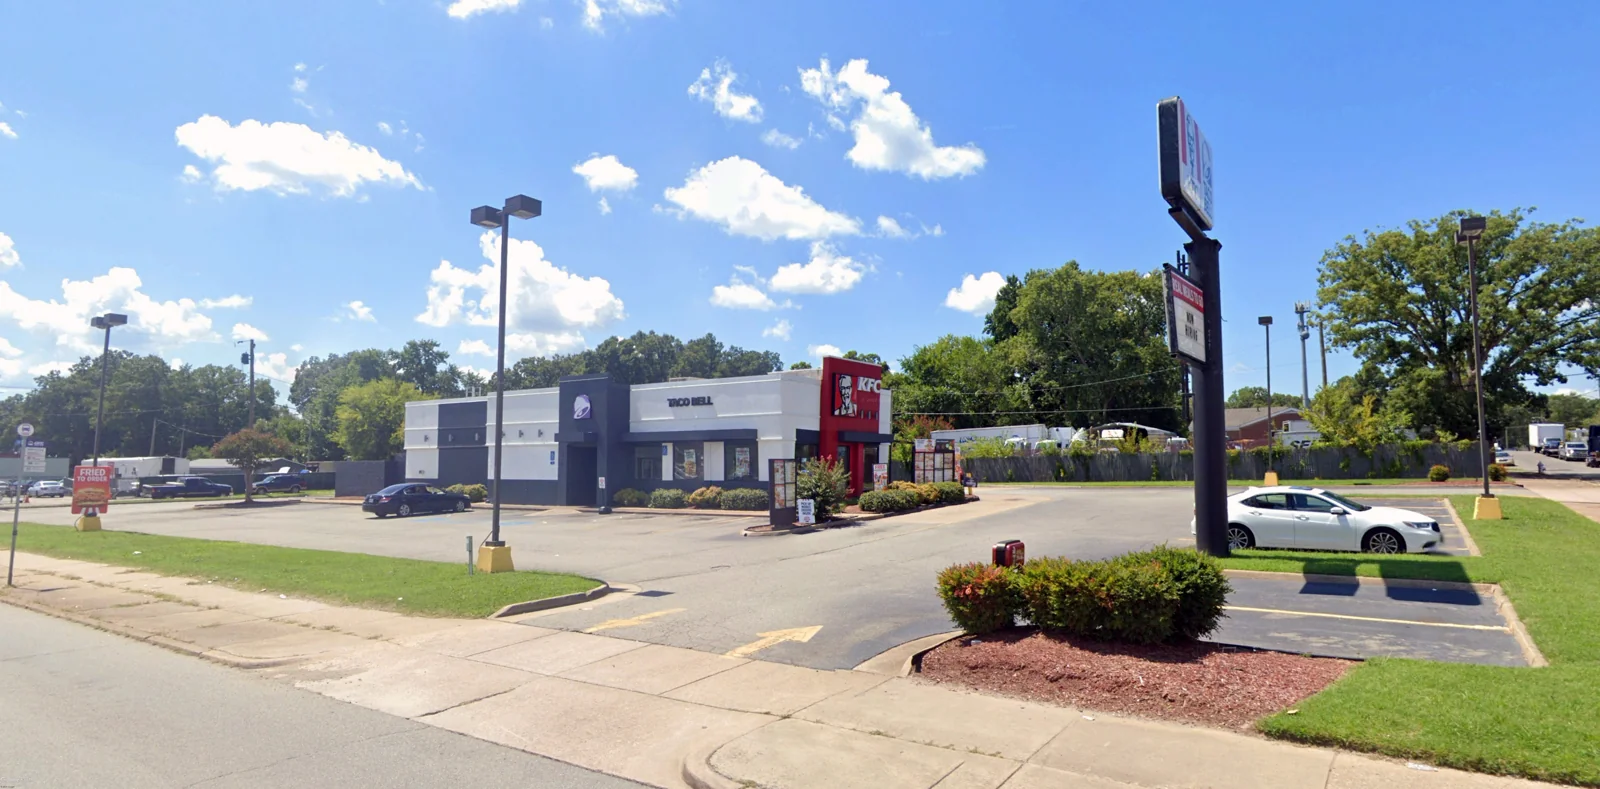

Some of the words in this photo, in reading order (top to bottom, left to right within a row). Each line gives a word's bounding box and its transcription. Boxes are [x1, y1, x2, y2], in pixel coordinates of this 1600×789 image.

[1186, 311, 1194, 324] NOW
[1185, 324, 1198, 341] HIRING
[857, 376, 882, 394] KFC
[666, 397, 691, 408] TACO
[691, 396, 714, 406] BELL
[80, 468, 106, 476] FRIED
